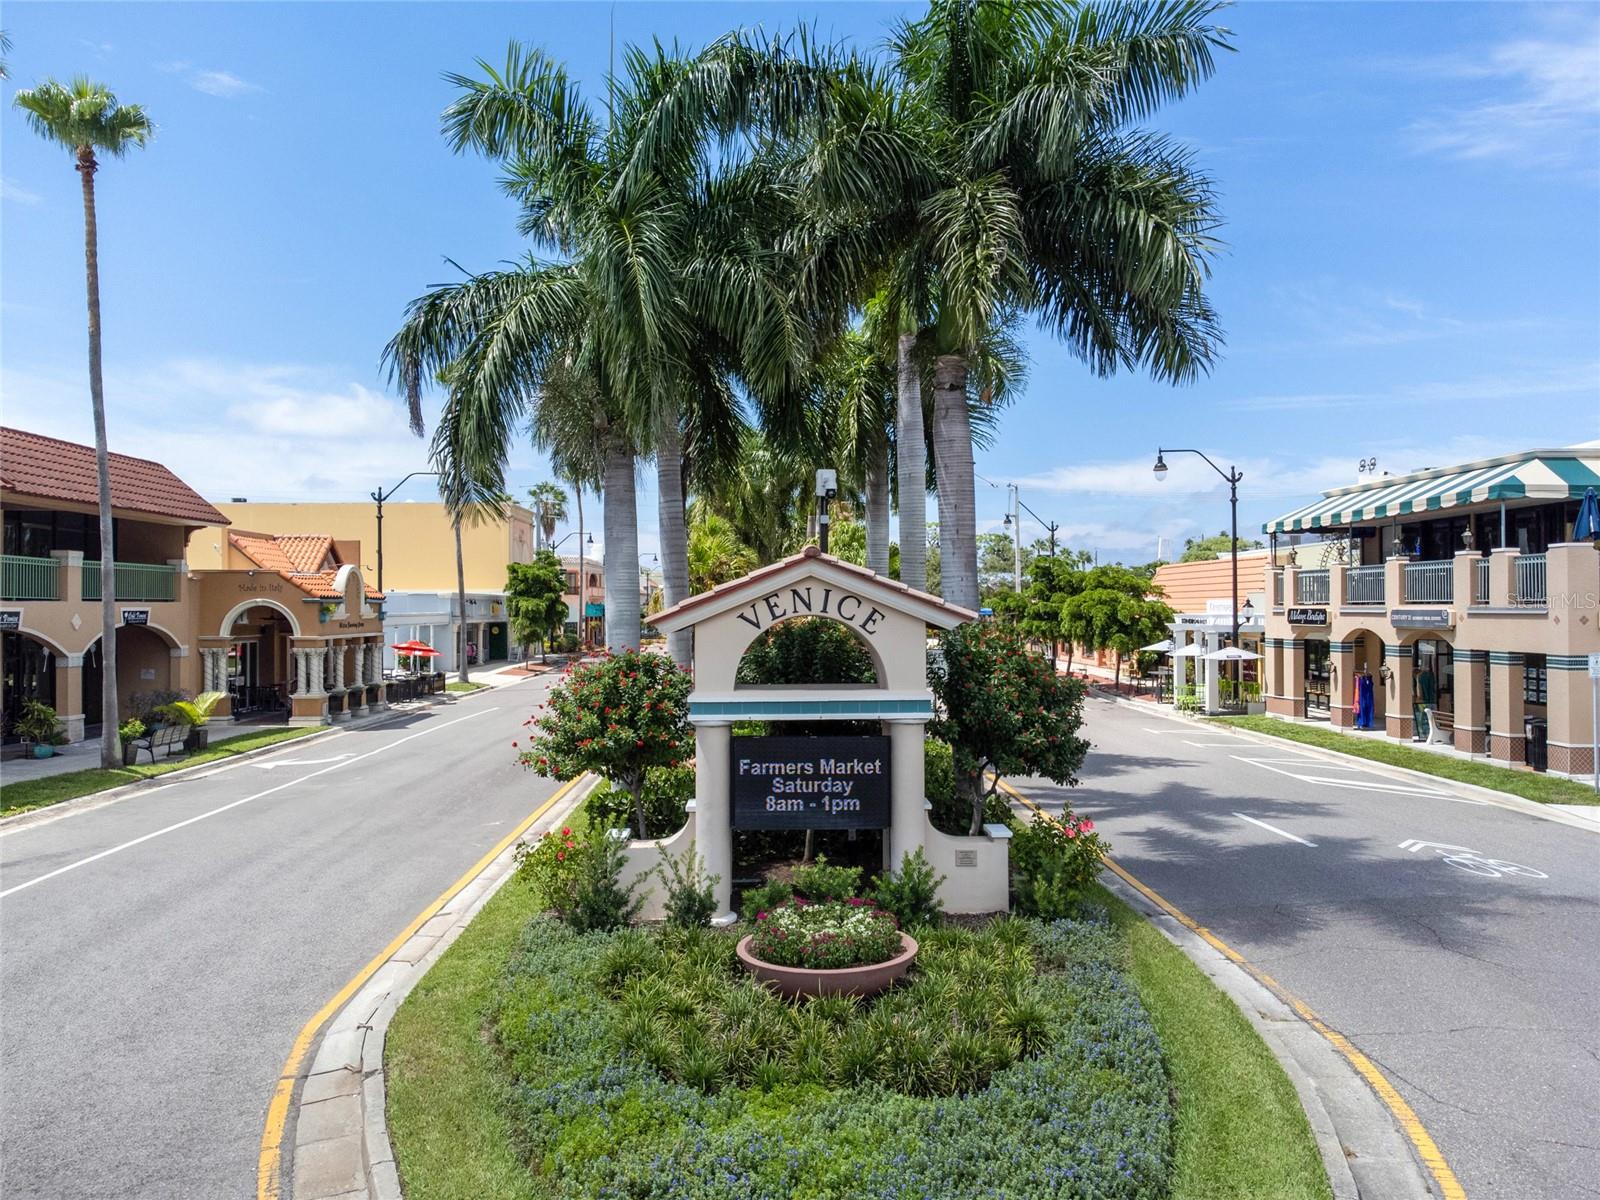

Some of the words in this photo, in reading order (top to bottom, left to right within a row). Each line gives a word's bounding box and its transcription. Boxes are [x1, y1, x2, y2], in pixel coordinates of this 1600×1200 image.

[736, 587, 886, 636] VENICE
[739, 759, 814, 775] Farmers
[820, 758, 882, 775] Market
[772, 777, 853, 796] Saturday
[766, 795, 804, 812] 8am
[821, 795, 860, 814] 1pm
